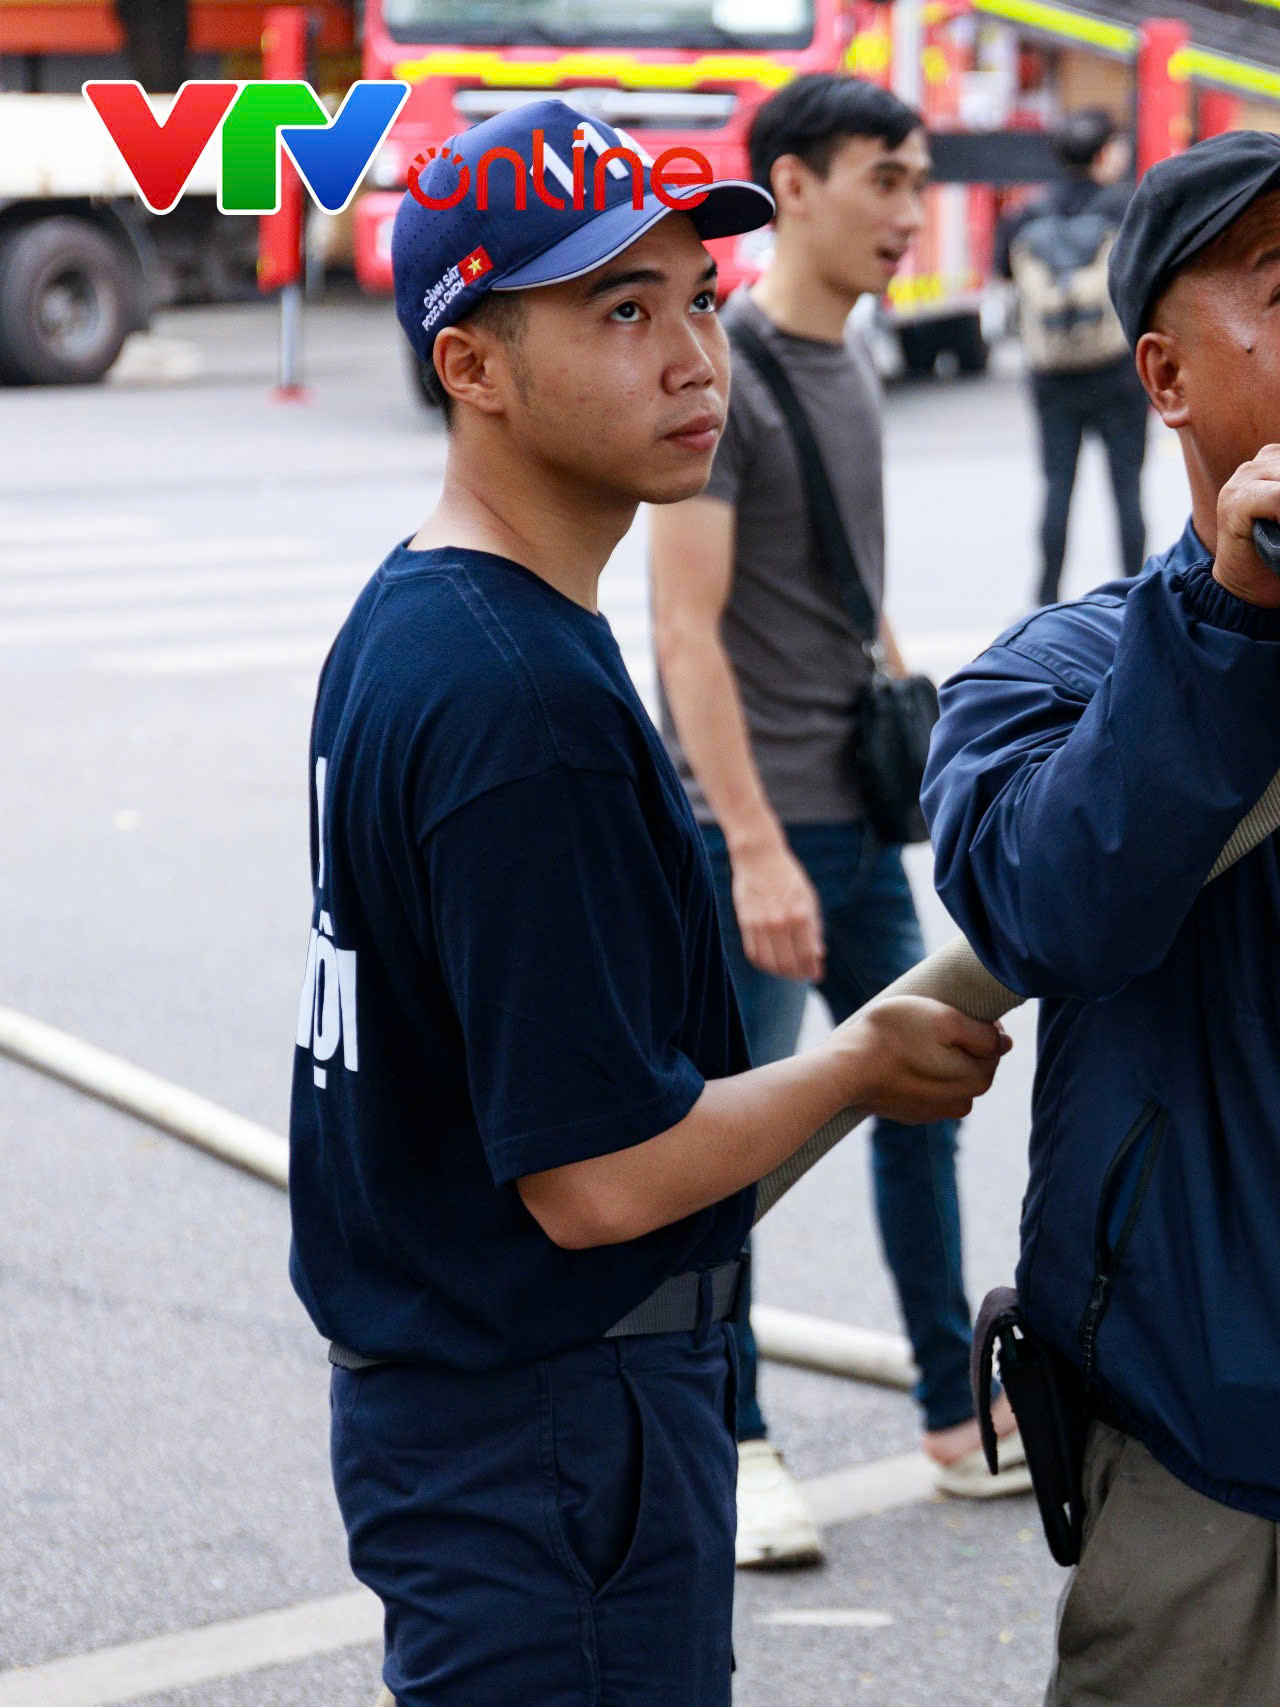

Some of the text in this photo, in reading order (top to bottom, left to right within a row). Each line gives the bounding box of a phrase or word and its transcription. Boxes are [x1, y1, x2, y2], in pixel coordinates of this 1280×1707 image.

[421, 305, 440, 332] PCCC
[443, 276, 465, 304] CNCH
[423, 265, 460, 310] CẢNH SÁT
